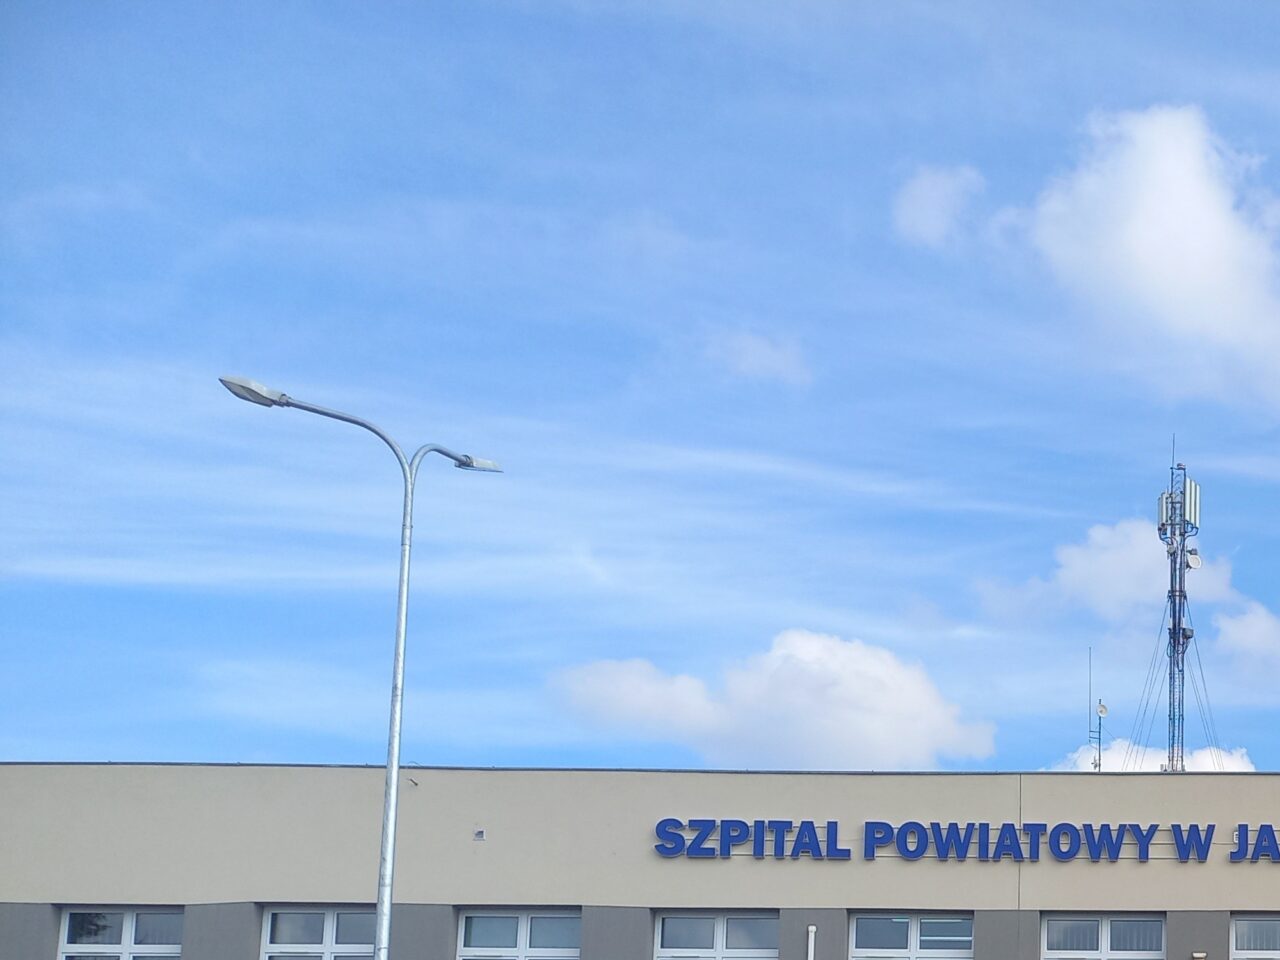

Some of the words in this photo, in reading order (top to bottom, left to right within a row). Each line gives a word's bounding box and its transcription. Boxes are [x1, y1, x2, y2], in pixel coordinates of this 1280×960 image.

[655, 818, 851, 859] SZPITAL
[864, 821, 1157, 862] POWIATOWY
[1172, 824, 1215, 862] W
